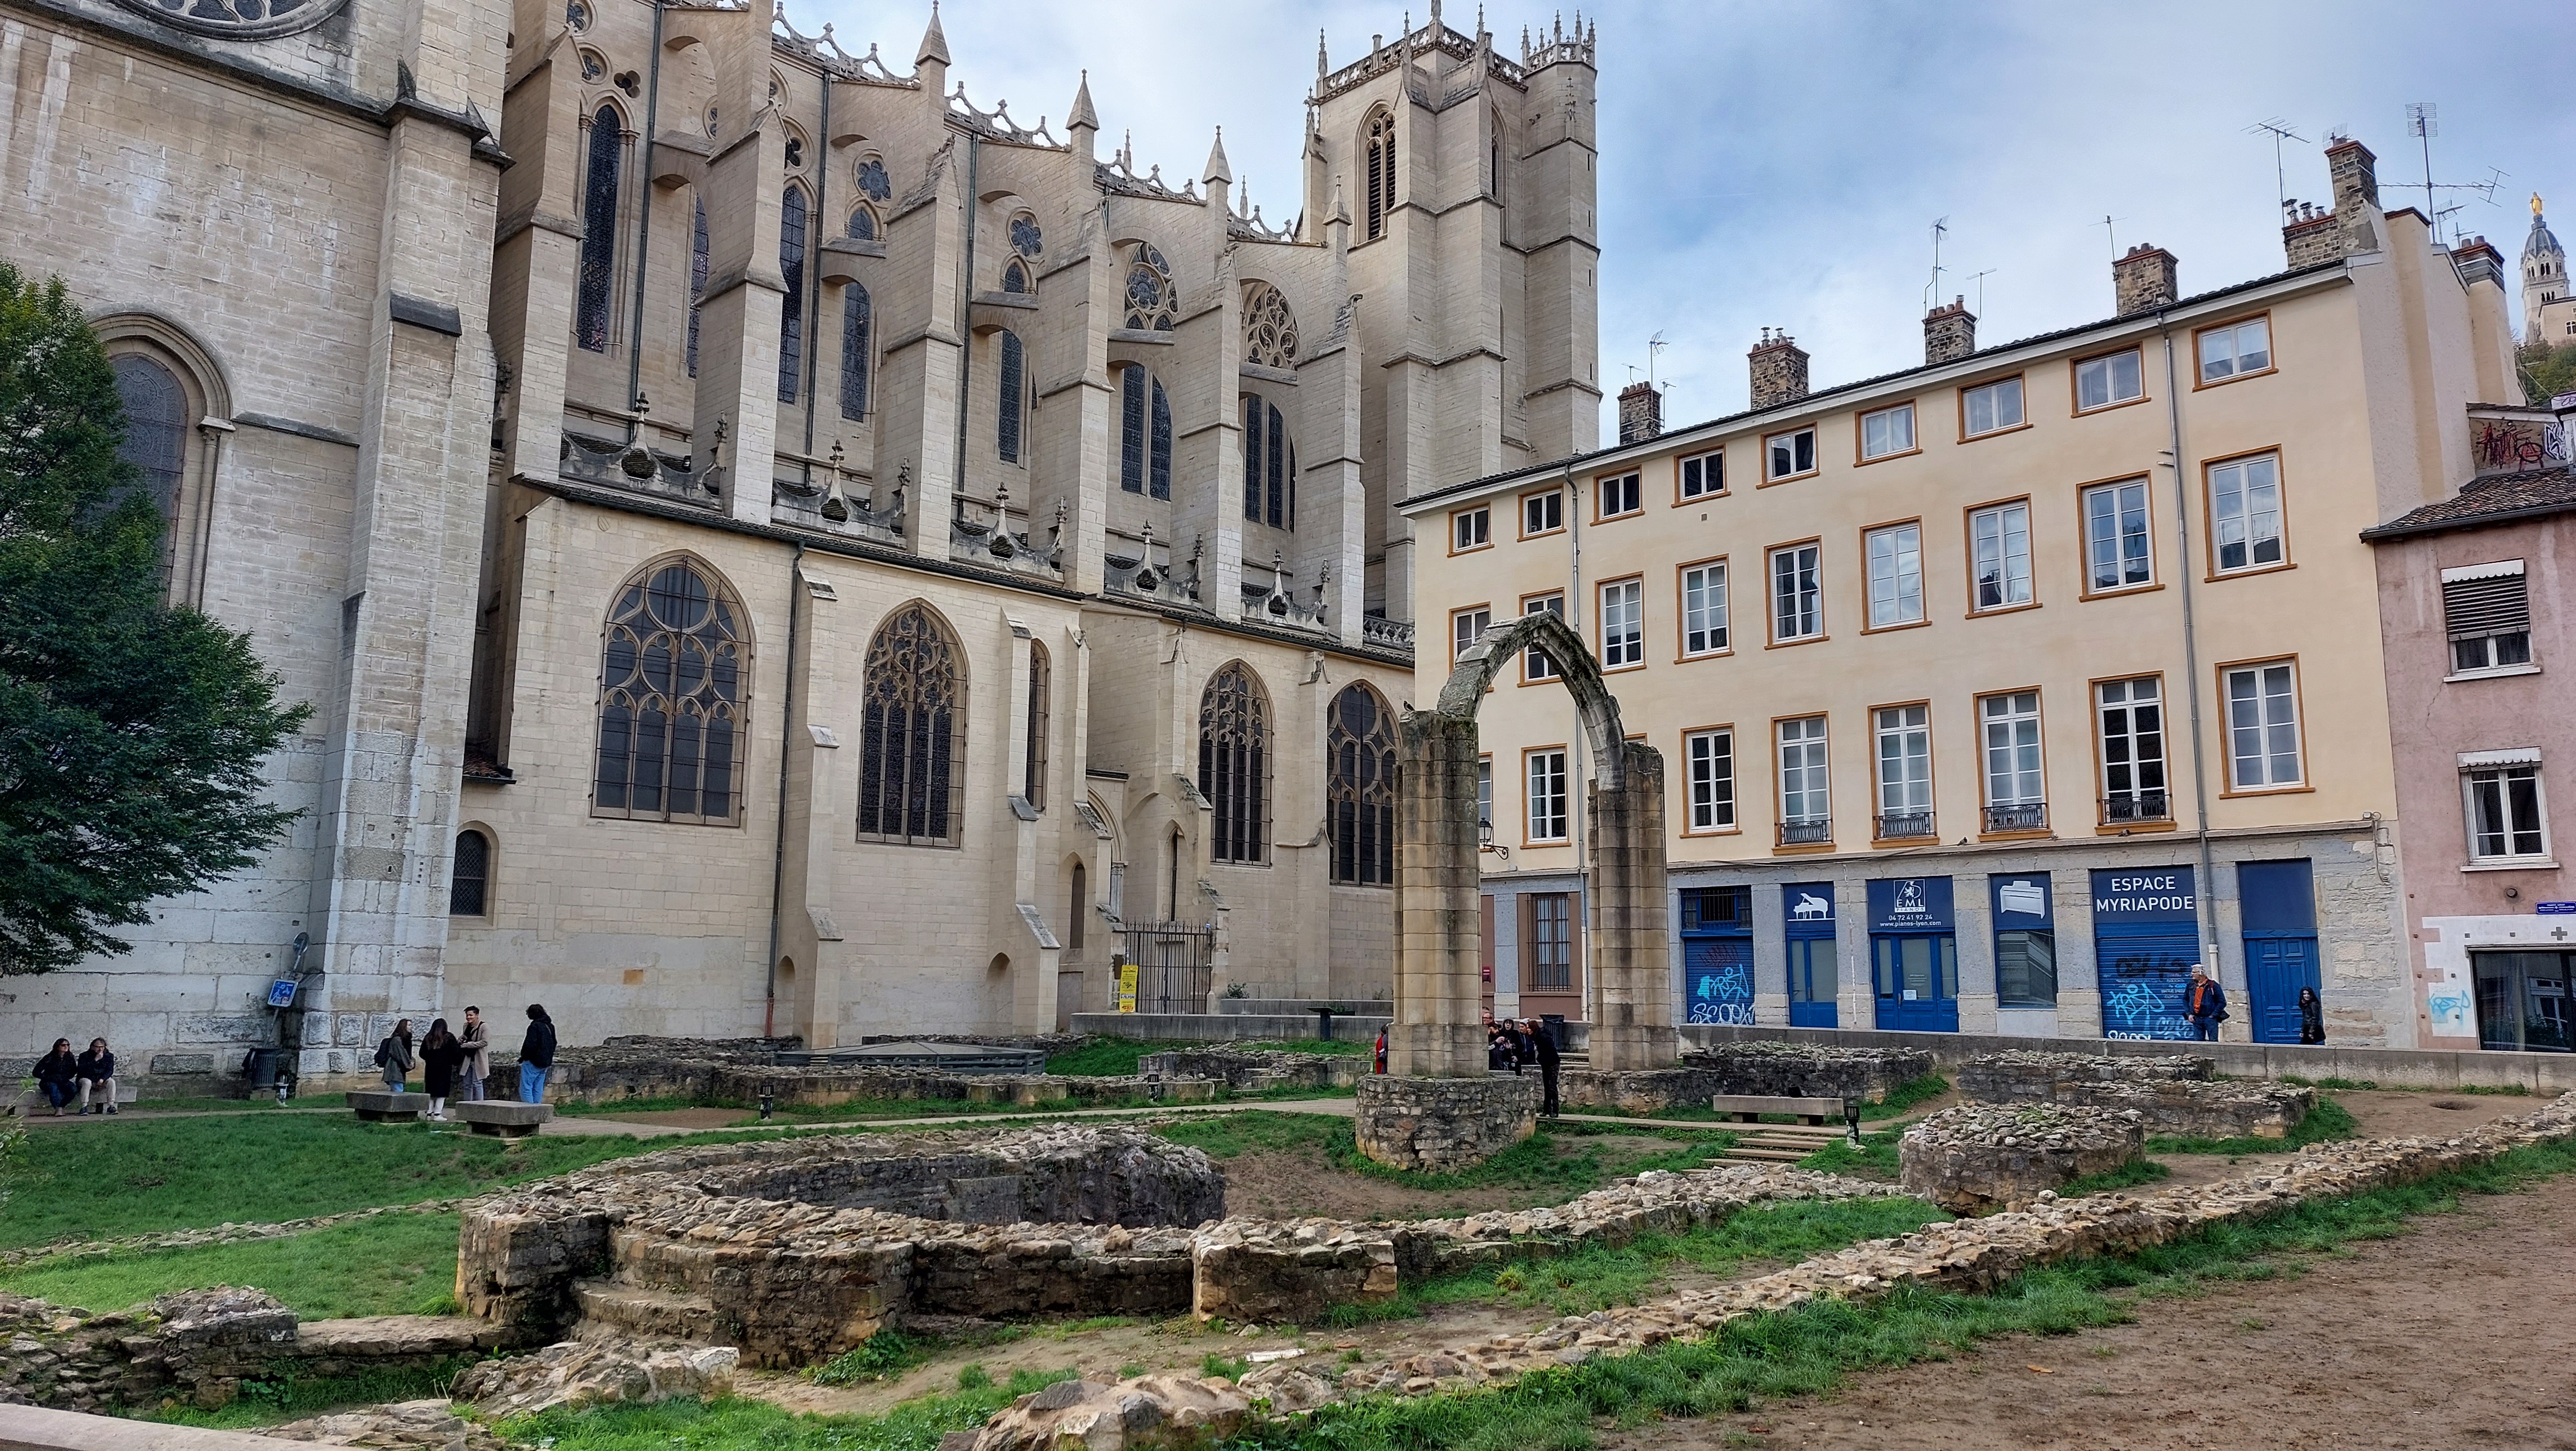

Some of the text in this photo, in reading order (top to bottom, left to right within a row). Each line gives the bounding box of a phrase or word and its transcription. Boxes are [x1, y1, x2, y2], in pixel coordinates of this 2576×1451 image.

[2111, 876, 2176, 892] ESPACE
[1896, 898, 1924, 908] EML
[2096, 896, 2194, 912] MYRIAPODE
